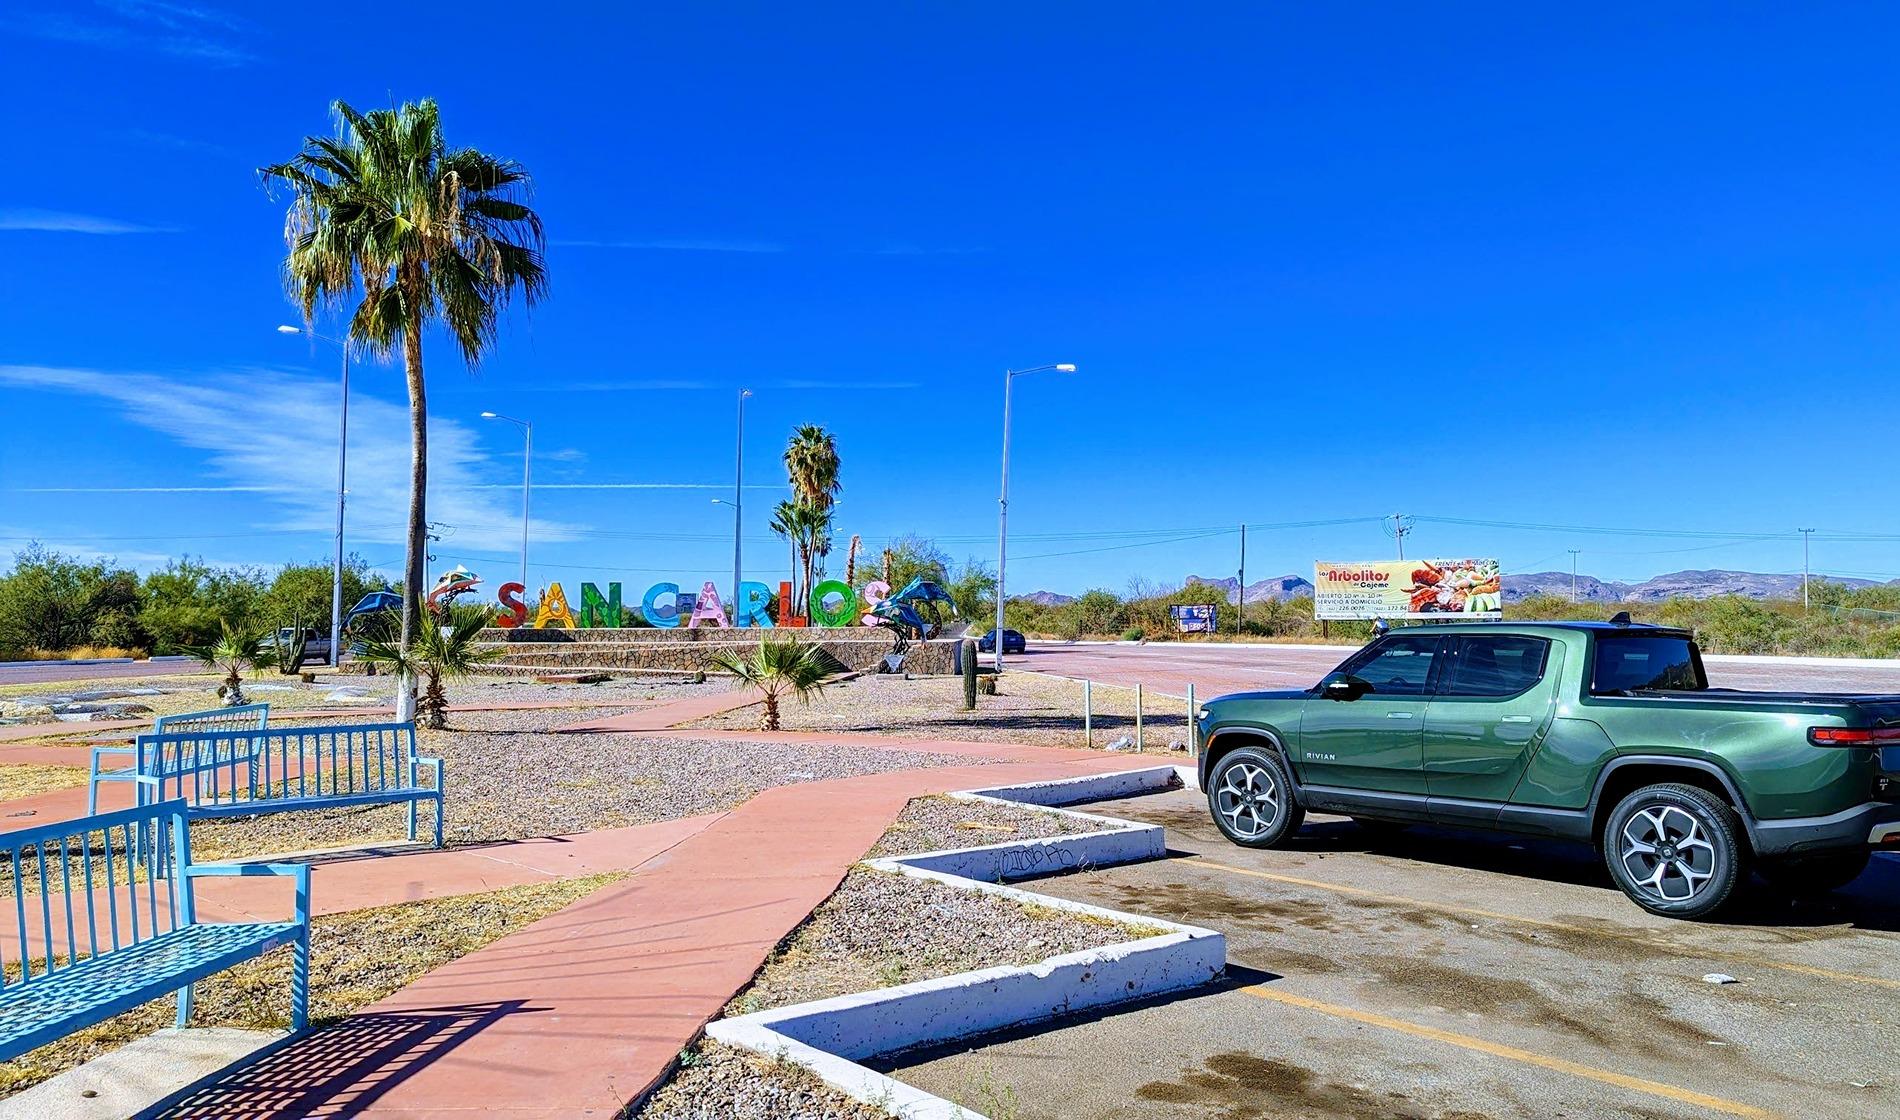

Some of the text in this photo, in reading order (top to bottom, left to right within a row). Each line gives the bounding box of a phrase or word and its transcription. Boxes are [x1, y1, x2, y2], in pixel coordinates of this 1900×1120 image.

[1329, 570, 1390, 581] Arbolitos
[497, 580, 892, 629] SAN CARLOS
